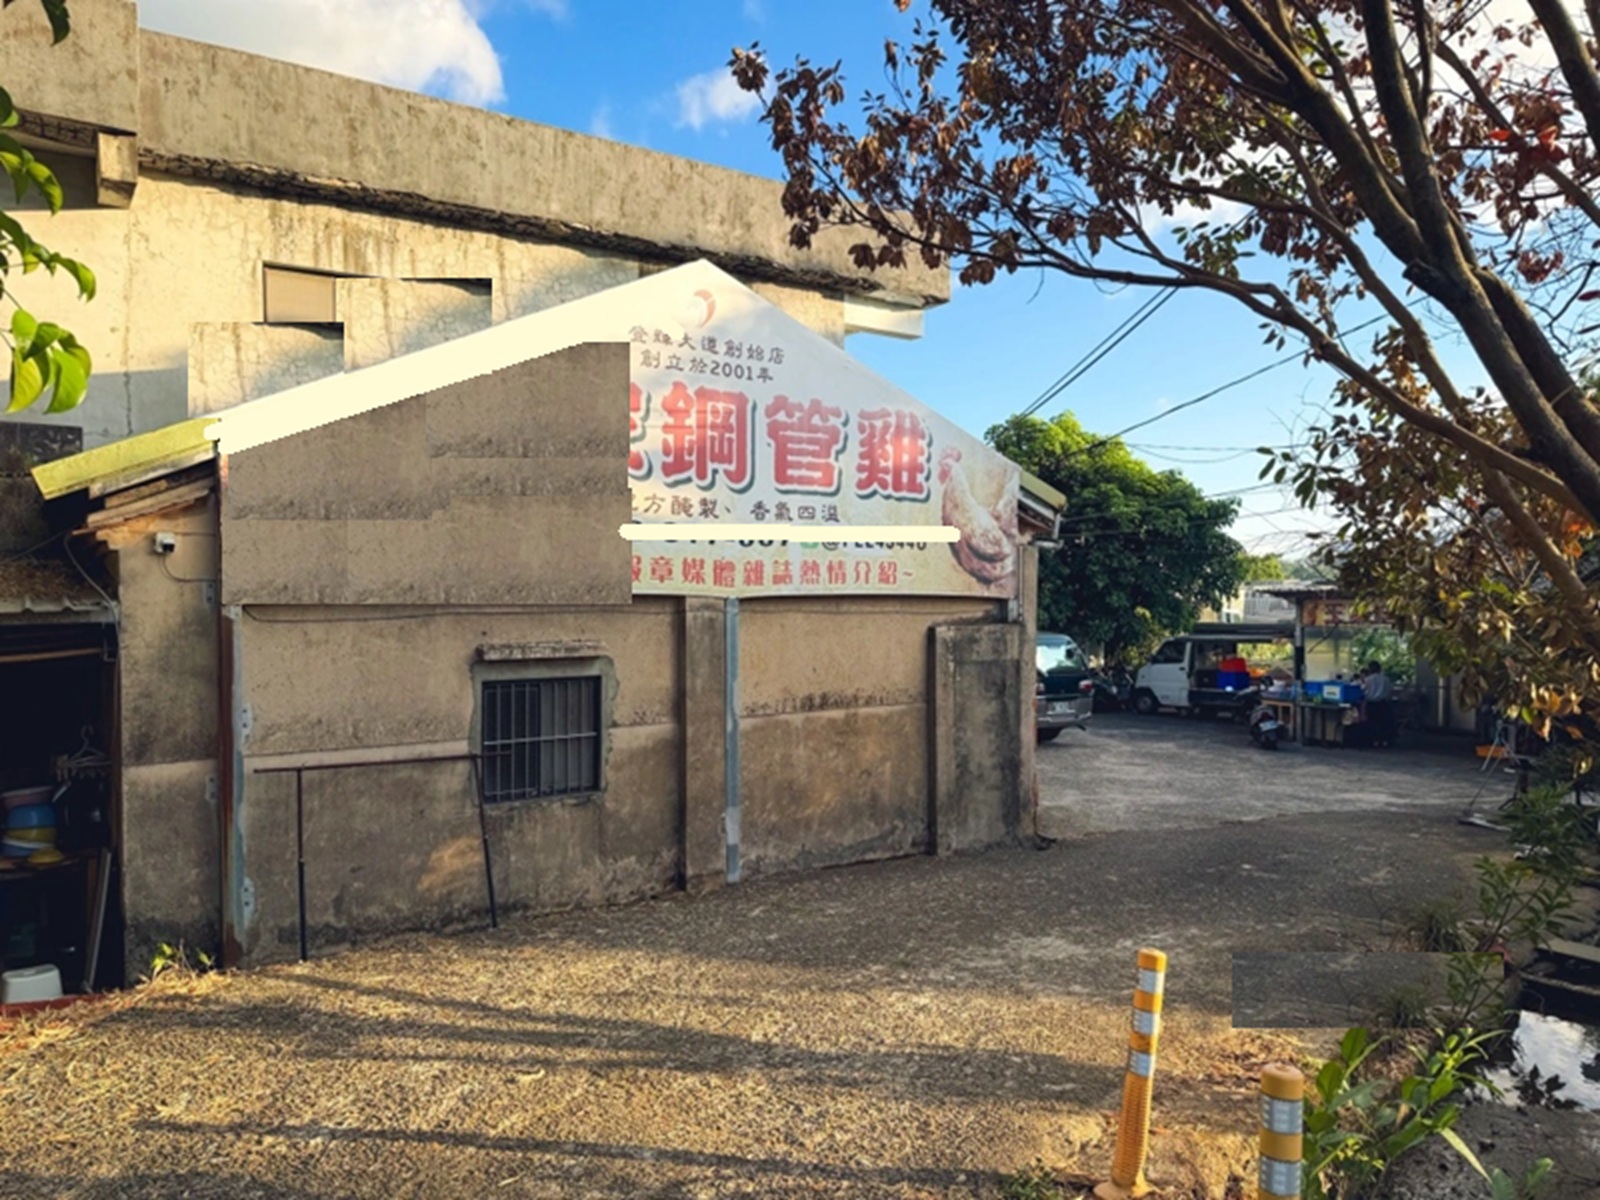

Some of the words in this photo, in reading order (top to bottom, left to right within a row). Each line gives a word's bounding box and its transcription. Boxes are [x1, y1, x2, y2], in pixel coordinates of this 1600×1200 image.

[640, 348, 774, 384] 創立於2001年
[629, 380, 928, 498] 鋼管雞
[632, 494, 840, 523] 方醃製、香氣四溢
